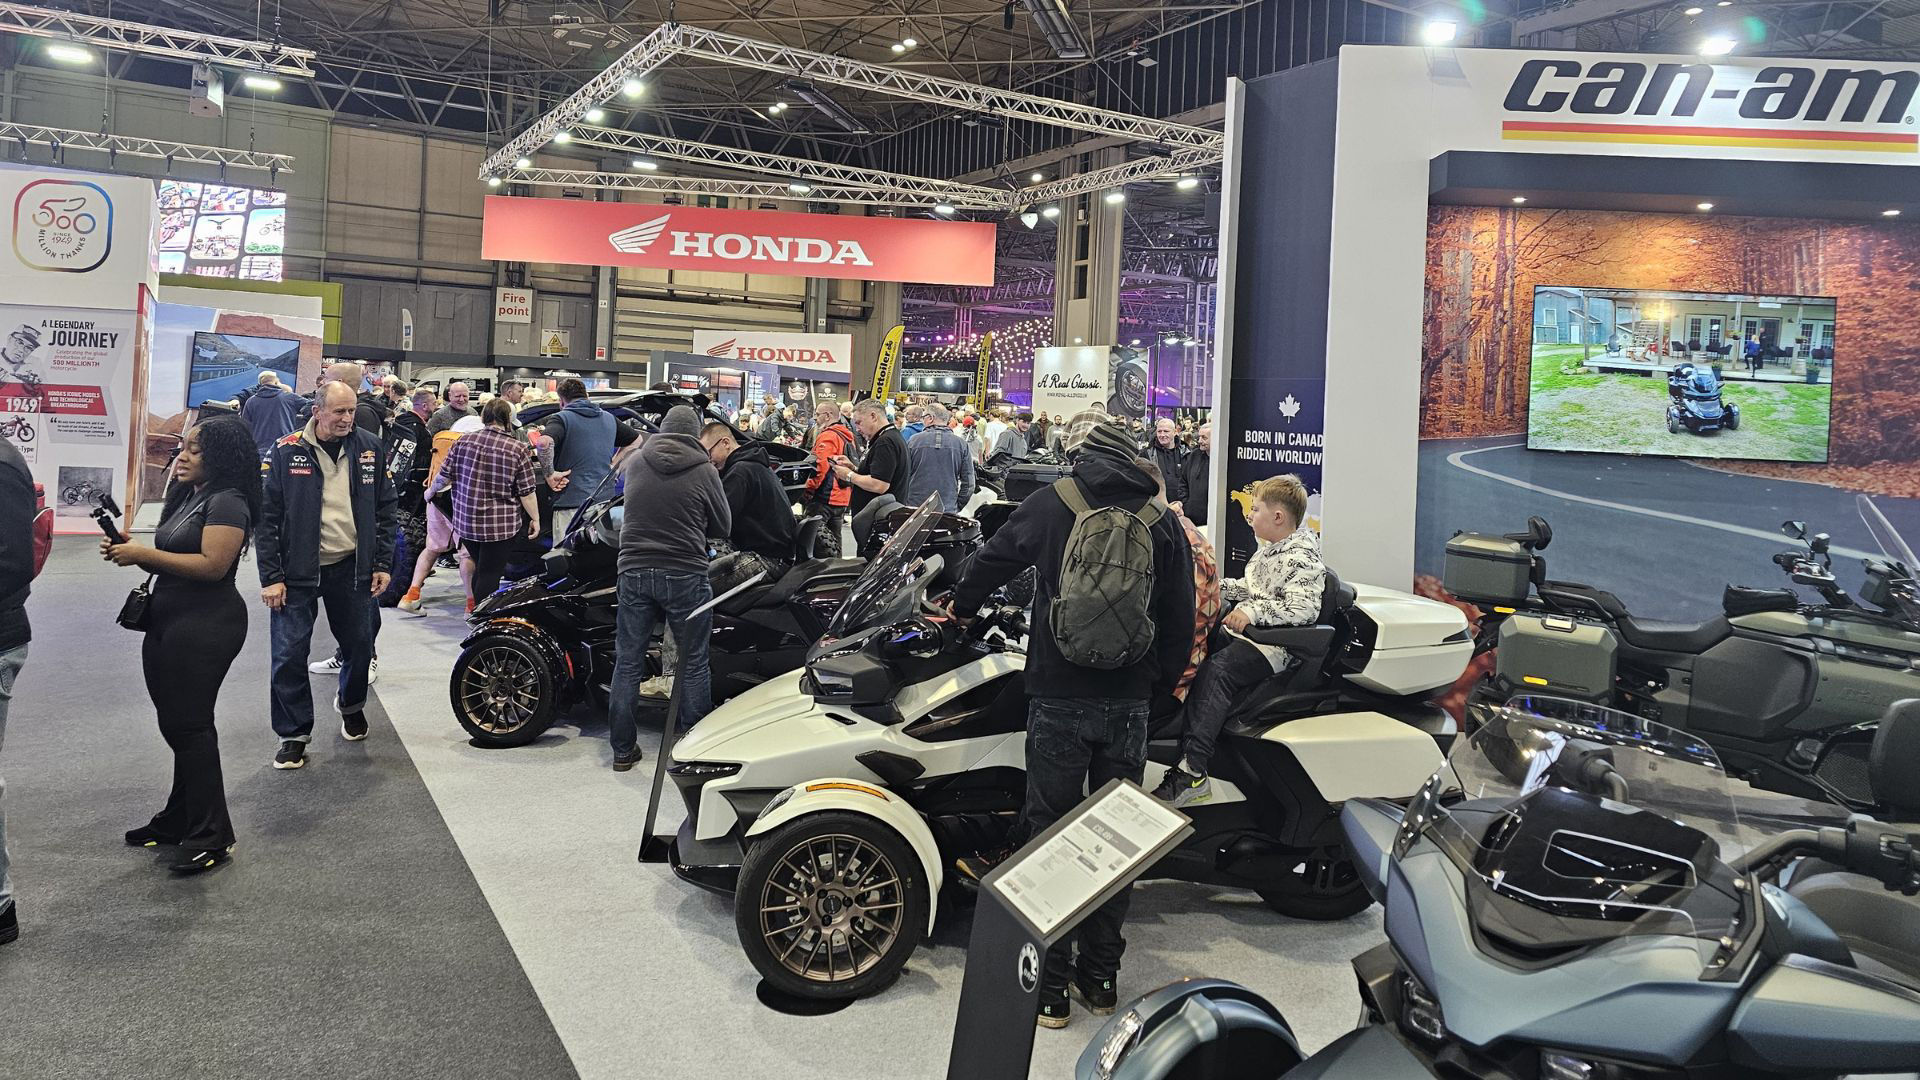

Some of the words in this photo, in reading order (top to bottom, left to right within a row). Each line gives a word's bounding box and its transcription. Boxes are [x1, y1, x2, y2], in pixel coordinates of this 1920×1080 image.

[38, 228, 57, 259] MILLION
[60, 236, 86, 260] THANKS
[52, 236, 73, 245] 1949
[669, 230, 874, 267] HONDA
[503, 293, 526, 304] Fire
[499, 306, 529, 316] point
[41, 319, 47, 328] A
[49, 319, 95, 330] LEGENDARY
[48, 330, 119, 349] JOURNEY
[737, 346, 837, 363] HONDA
[875, 351, 891, 400] cottoiler
[1037, 373, 1049, 388] A
[1049, 373, 1071, 388] Real
[1071, 373, 1102, 389] Classic.
[6, 398, 38, 413] 1949
[1245, 430, 1272, 444] BORN
[1274, 431, 1285, 445] IN
[1289, 433, 1324, 447] CANAD
[1237, 446, 1272, 461] RIDDEN
[1276, 449, 1323, 466] WORLDW
